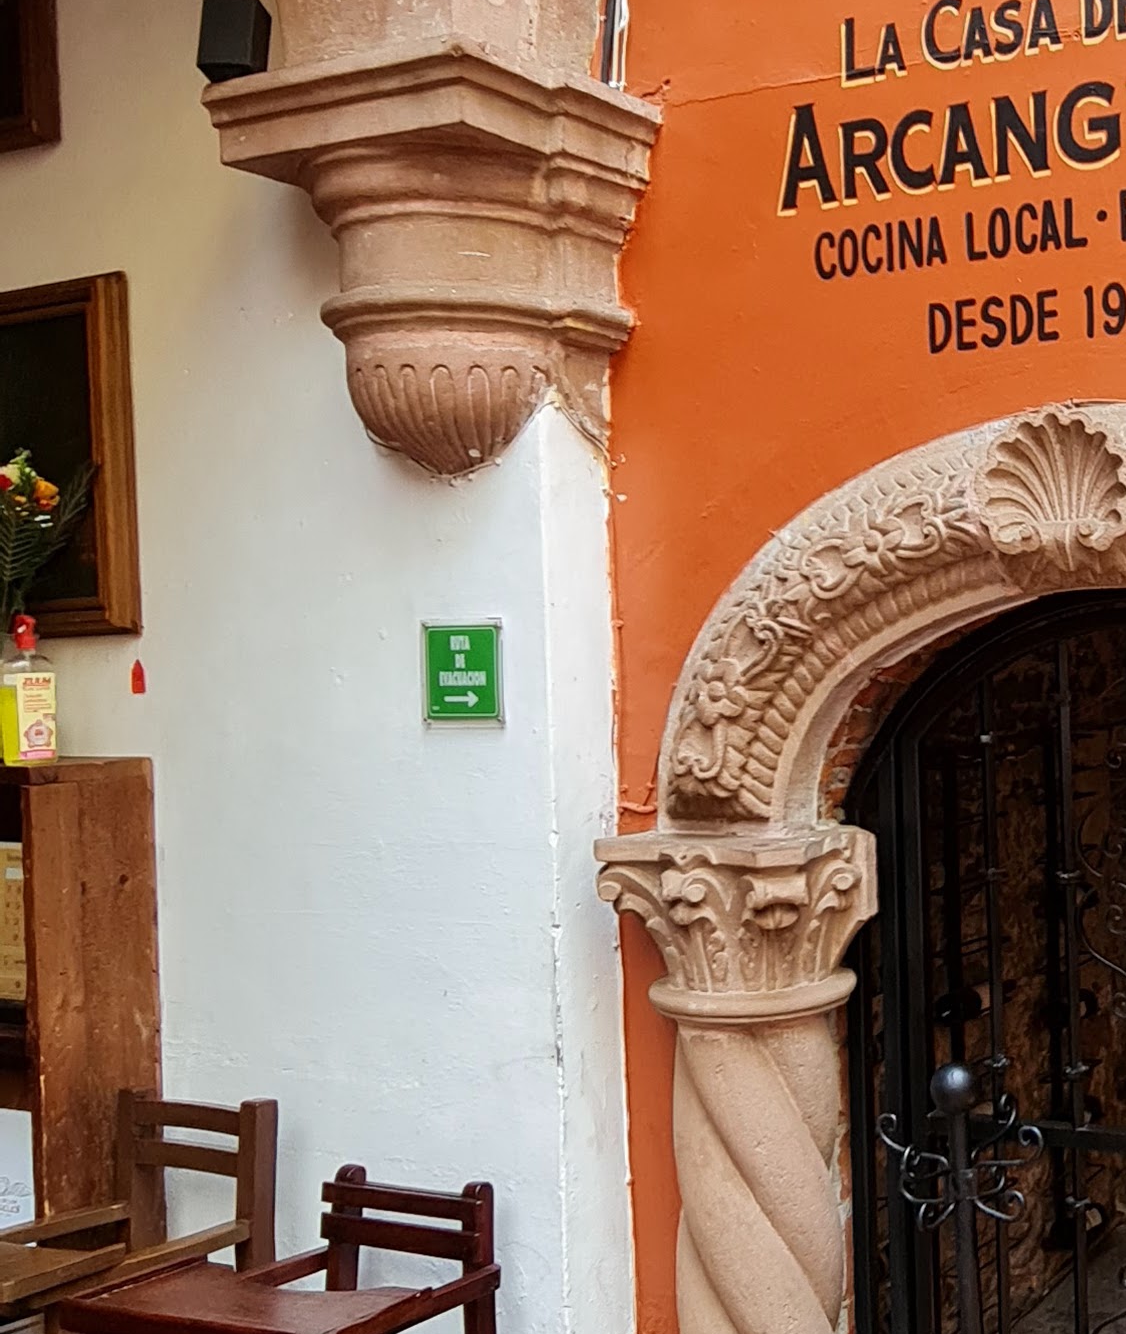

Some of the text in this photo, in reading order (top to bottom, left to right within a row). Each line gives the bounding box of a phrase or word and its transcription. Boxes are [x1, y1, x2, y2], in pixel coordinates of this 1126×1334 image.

[840, 17, 908, 86] LA
[813, 215, 949, 281] COCINA
[964, 196, 1090, 263] LOCAL
[927, 288, 1061, 356] DESDE
